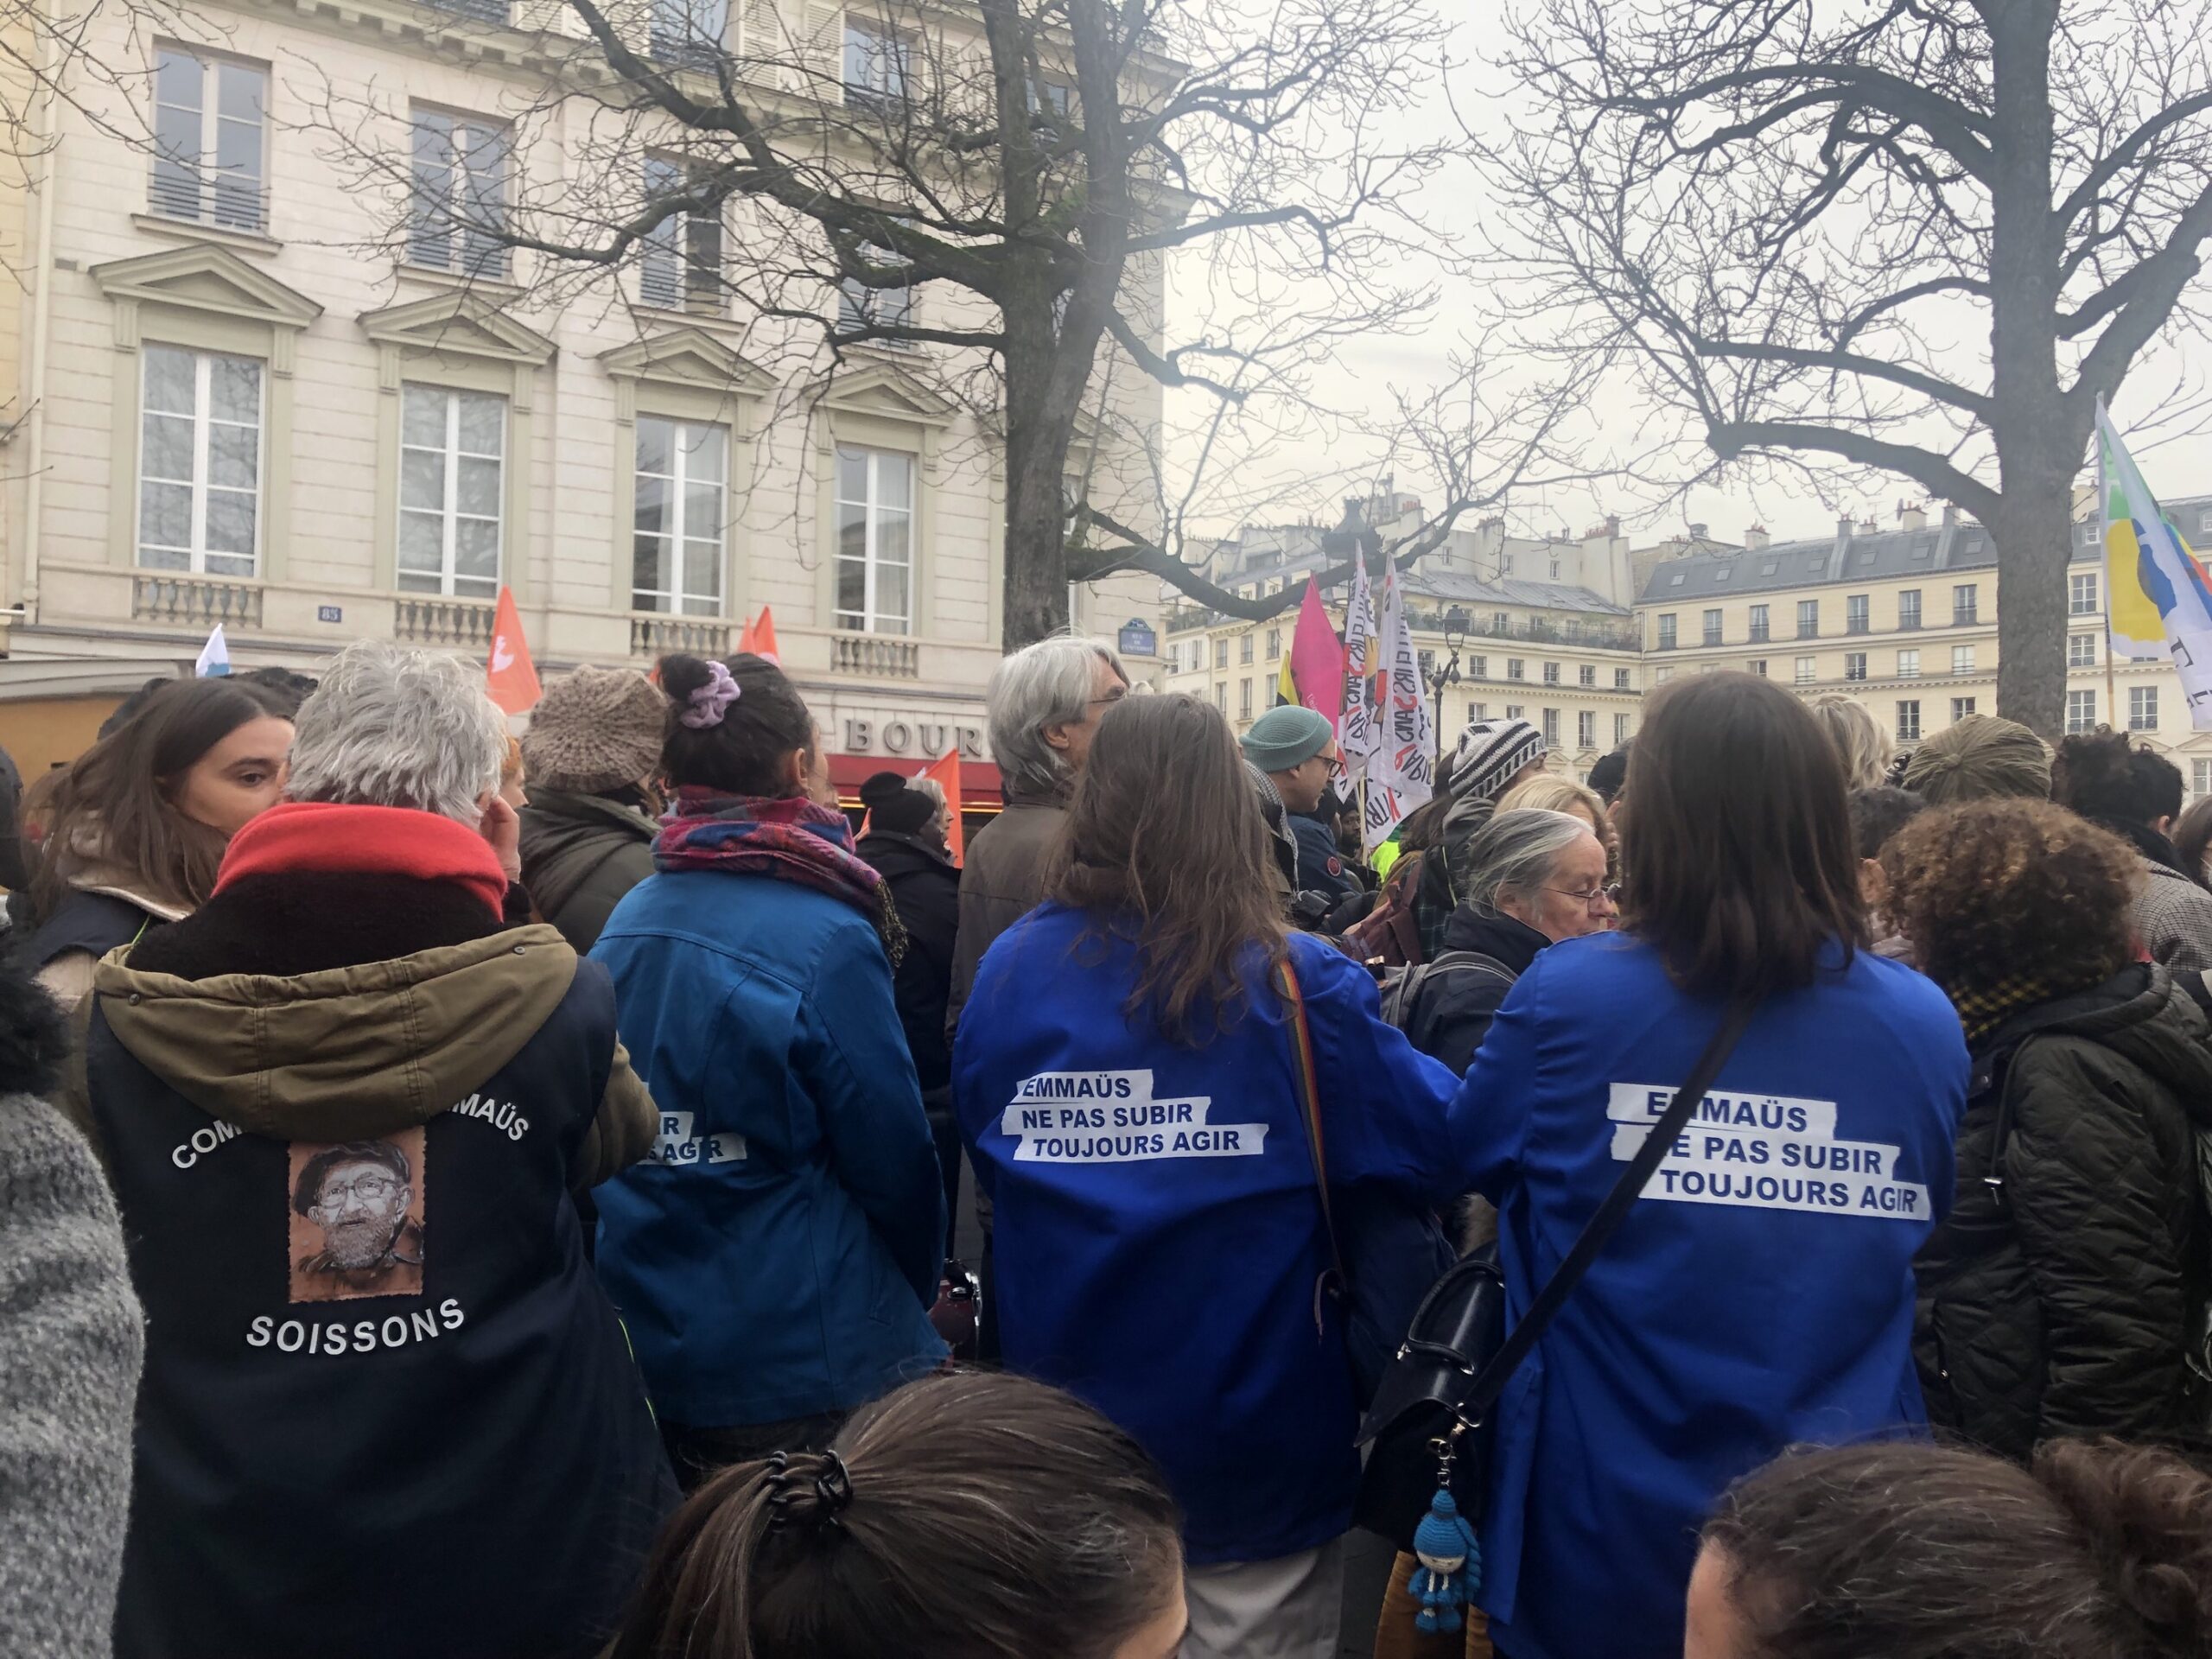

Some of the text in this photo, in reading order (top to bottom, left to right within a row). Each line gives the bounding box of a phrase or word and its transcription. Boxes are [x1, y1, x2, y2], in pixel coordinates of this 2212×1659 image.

[845, 719, 994, 759] BOUR
[1023, 1074, 1131, 1098] EMMAÜS
[172, 1093, 529, 1169] COM MAÜS
[1022, 1103, 1192, 1129] NE PAS SUBIR
[663, 1140, 724, 1160] AGR
[1033, 1131, 1241, 1158] TOUJOURS AGIR
[1646, 1133, 1882, 1175] E PAS SUBIR
[1659, 1169, 1918, 1213] TOUJOURS AGIR
[246, 1299, 465, 1355] SOISSONS
